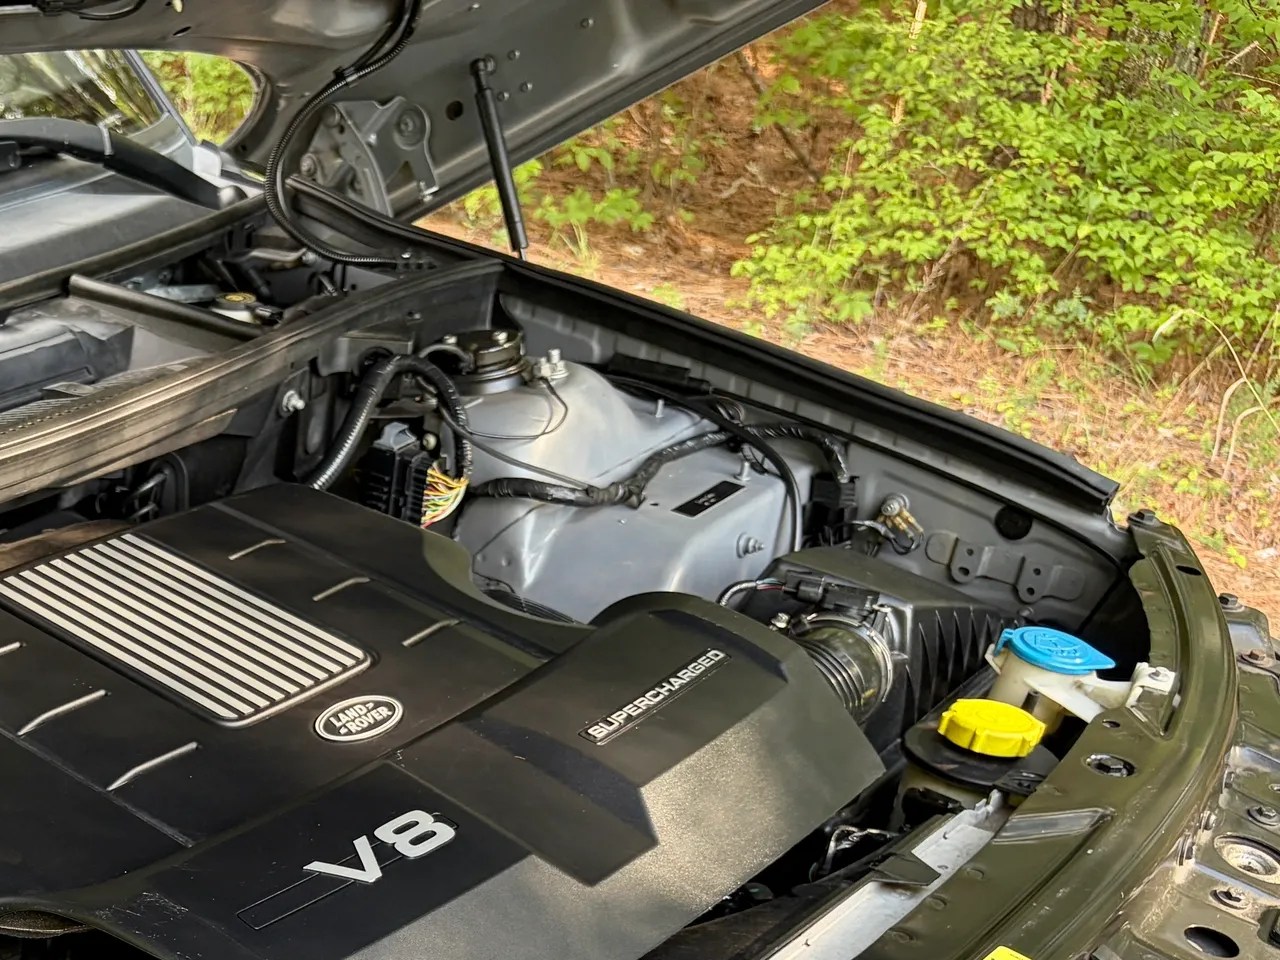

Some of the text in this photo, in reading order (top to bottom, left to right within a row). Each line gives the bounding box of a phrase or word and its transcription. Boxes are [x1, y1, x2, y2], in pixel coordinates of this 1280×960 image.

[329, 704, 367, 728] LAND
[587, 649, 726, 739] SUPERCHARGED
[345, 706, 393, 733] ROVER
[302, 809, 457, 883] V8
